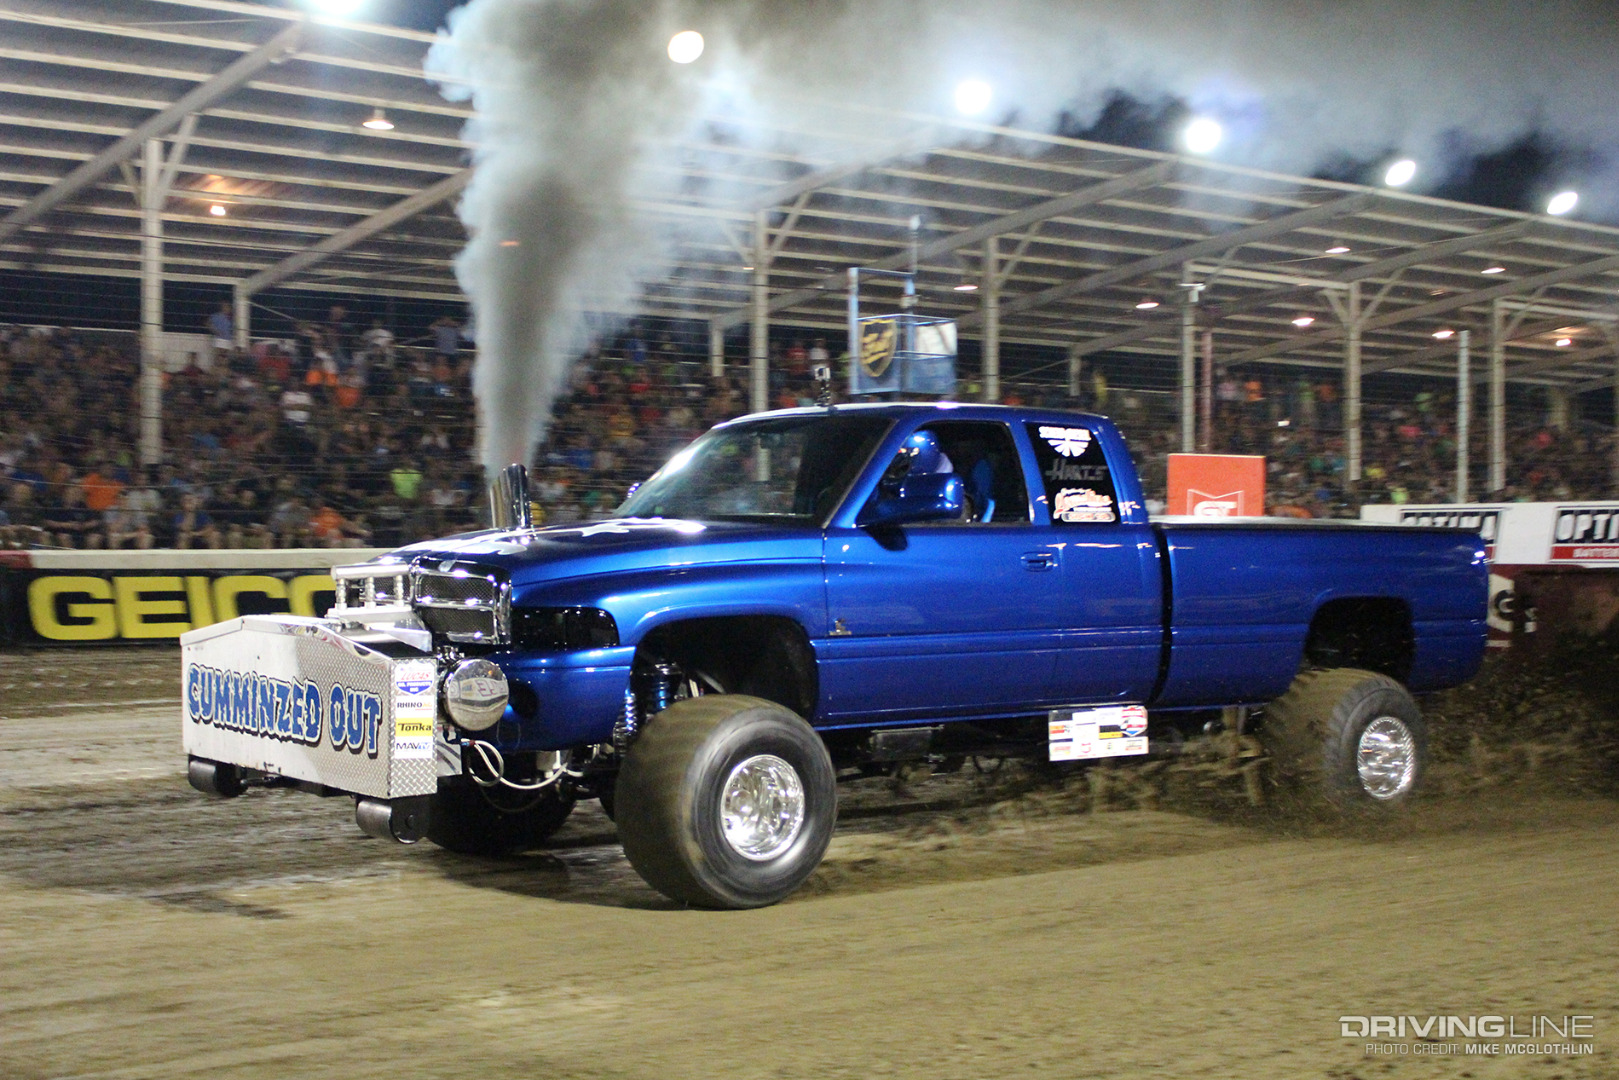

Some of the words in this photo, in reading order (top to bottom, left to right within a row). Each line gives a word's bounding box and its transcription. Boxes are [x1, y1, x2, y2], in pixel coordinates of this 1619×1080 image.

[401, 671, 431, 680] LUCAS
[188, 664, 322, 743] CUMMINZED
[329, 682, 383, 758] OUT
[398, 722, 432, 732] Tonka
